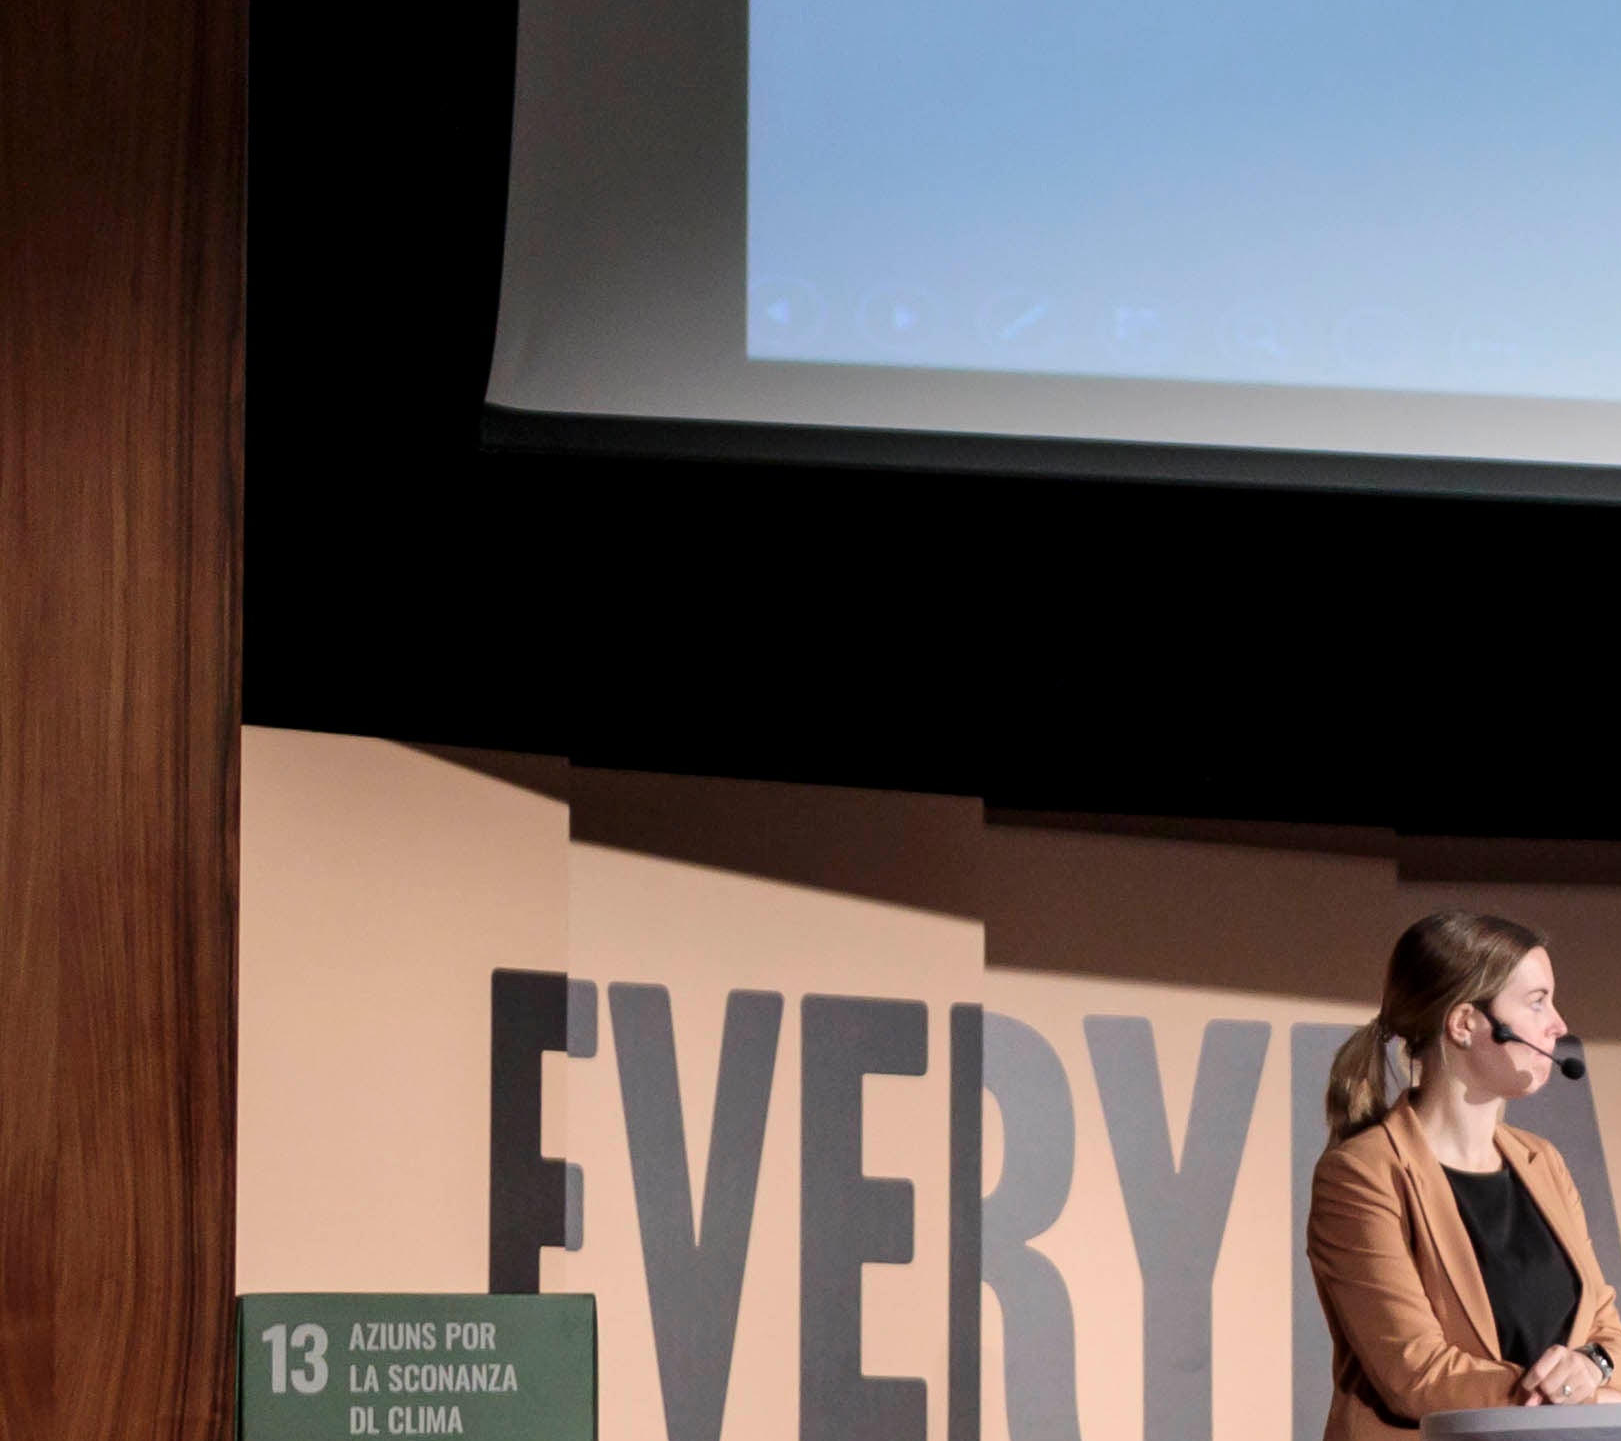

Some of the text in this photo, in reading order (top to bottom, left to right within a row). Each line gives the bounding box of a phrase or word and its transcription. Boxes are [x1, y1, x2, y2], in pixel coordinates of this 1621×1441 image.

[350, 1322, 496, 1351] AZIUNS POR
[262, 1323, 329, 1394] 13
[350, 1364, 518, 1392] LA SCONANZA
[350, 1406, 464, 1434] DL CLIMA
